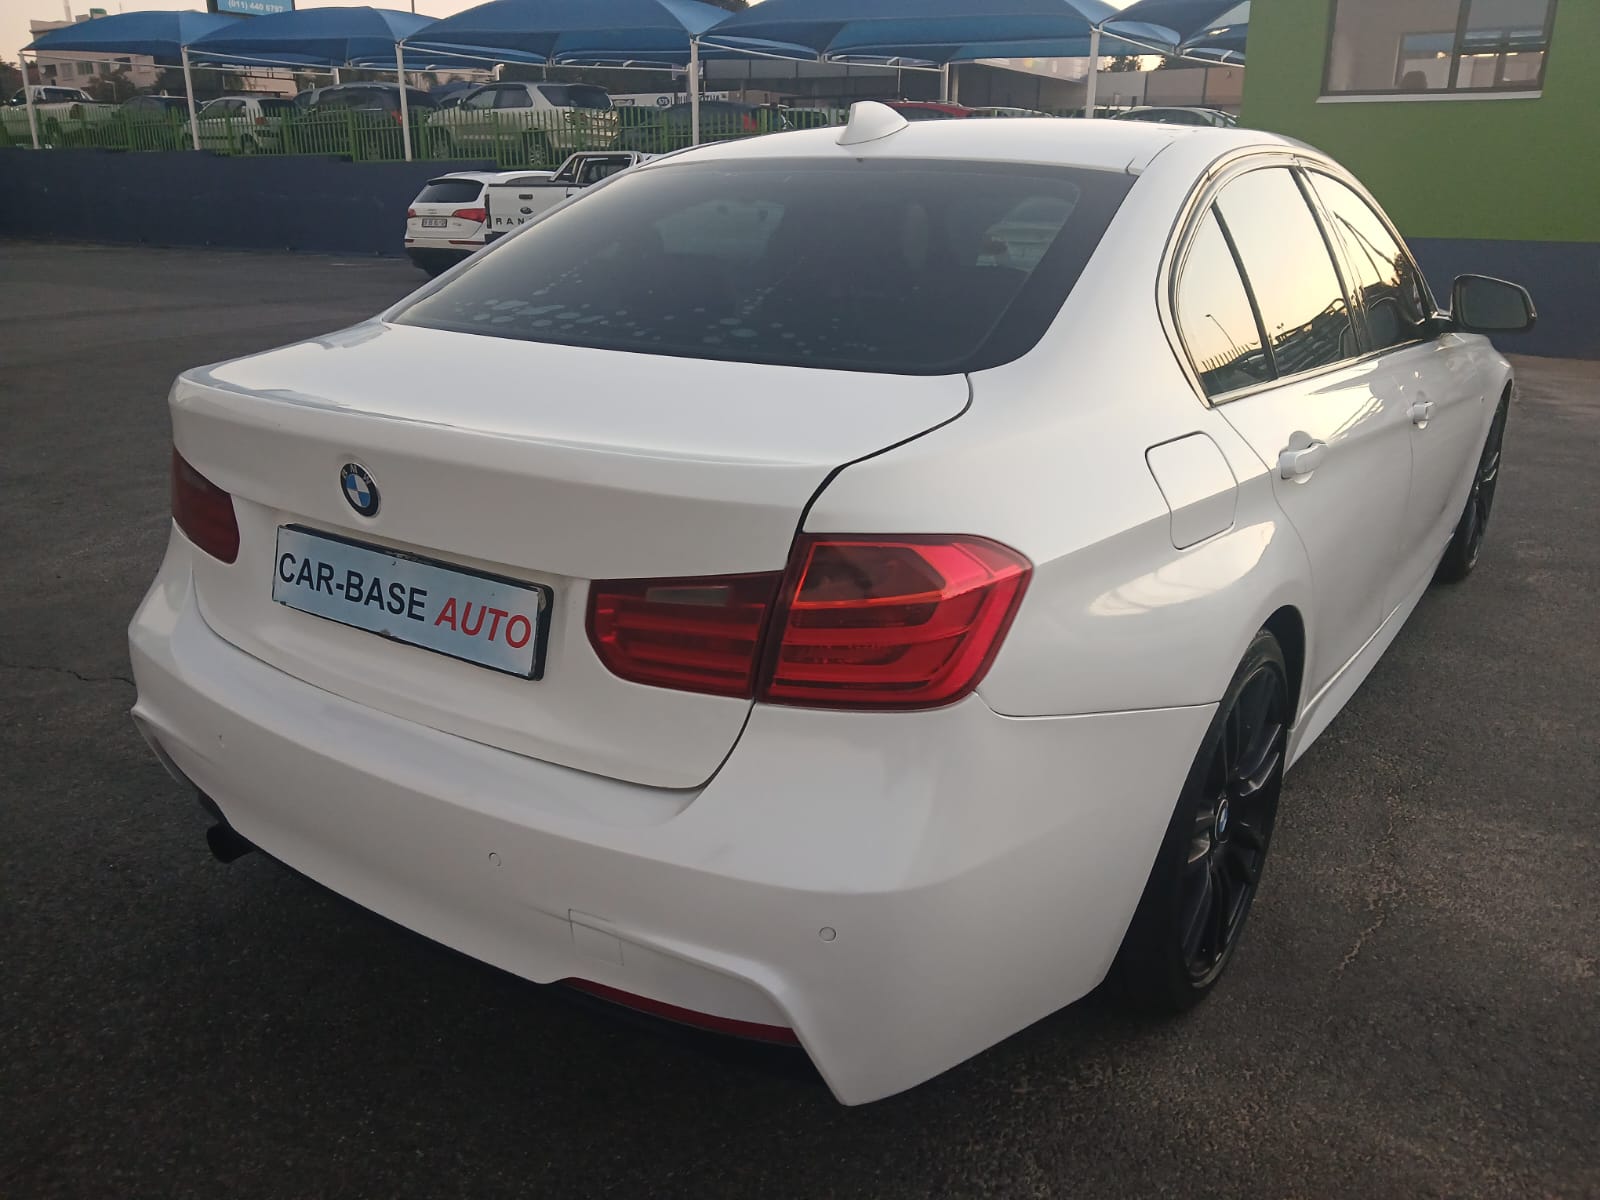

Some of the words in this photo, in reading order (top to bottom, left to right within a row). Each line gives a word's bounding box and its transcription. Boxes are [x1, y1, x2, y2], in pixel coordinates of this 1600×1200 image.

[495, 217, 531, 225] RAN
[279, 553, 428, 622] CAR-BASE
[434, 597, 532, 648] AUTO
